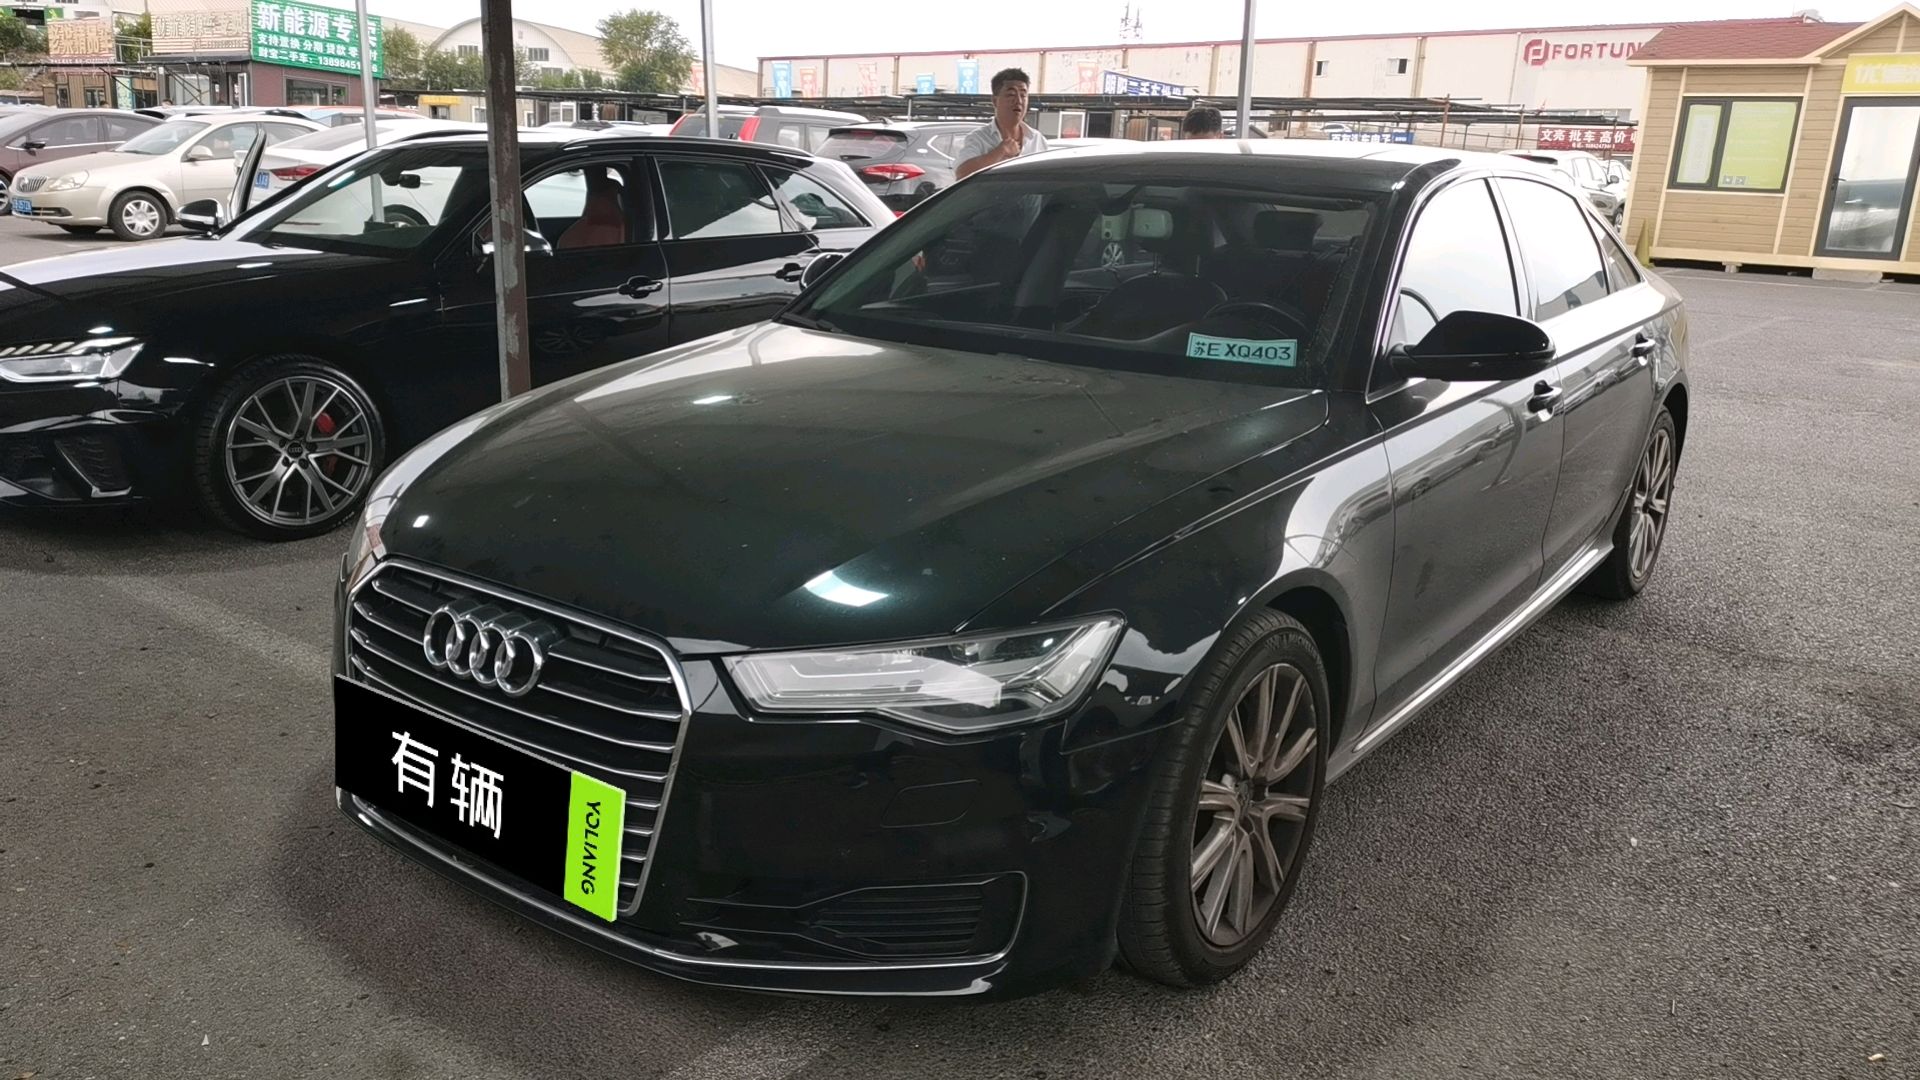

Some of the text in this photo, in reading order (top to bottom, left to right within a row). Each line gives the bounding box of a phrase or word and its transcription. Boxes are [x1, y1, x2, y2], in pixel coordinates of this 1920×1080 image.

[257, 33, 300, 50] 支持置换
[303, 39, 324, 53] 分期
[348, 46, 378, 61] 零付
[318, 56, 378, 73] 138984516
